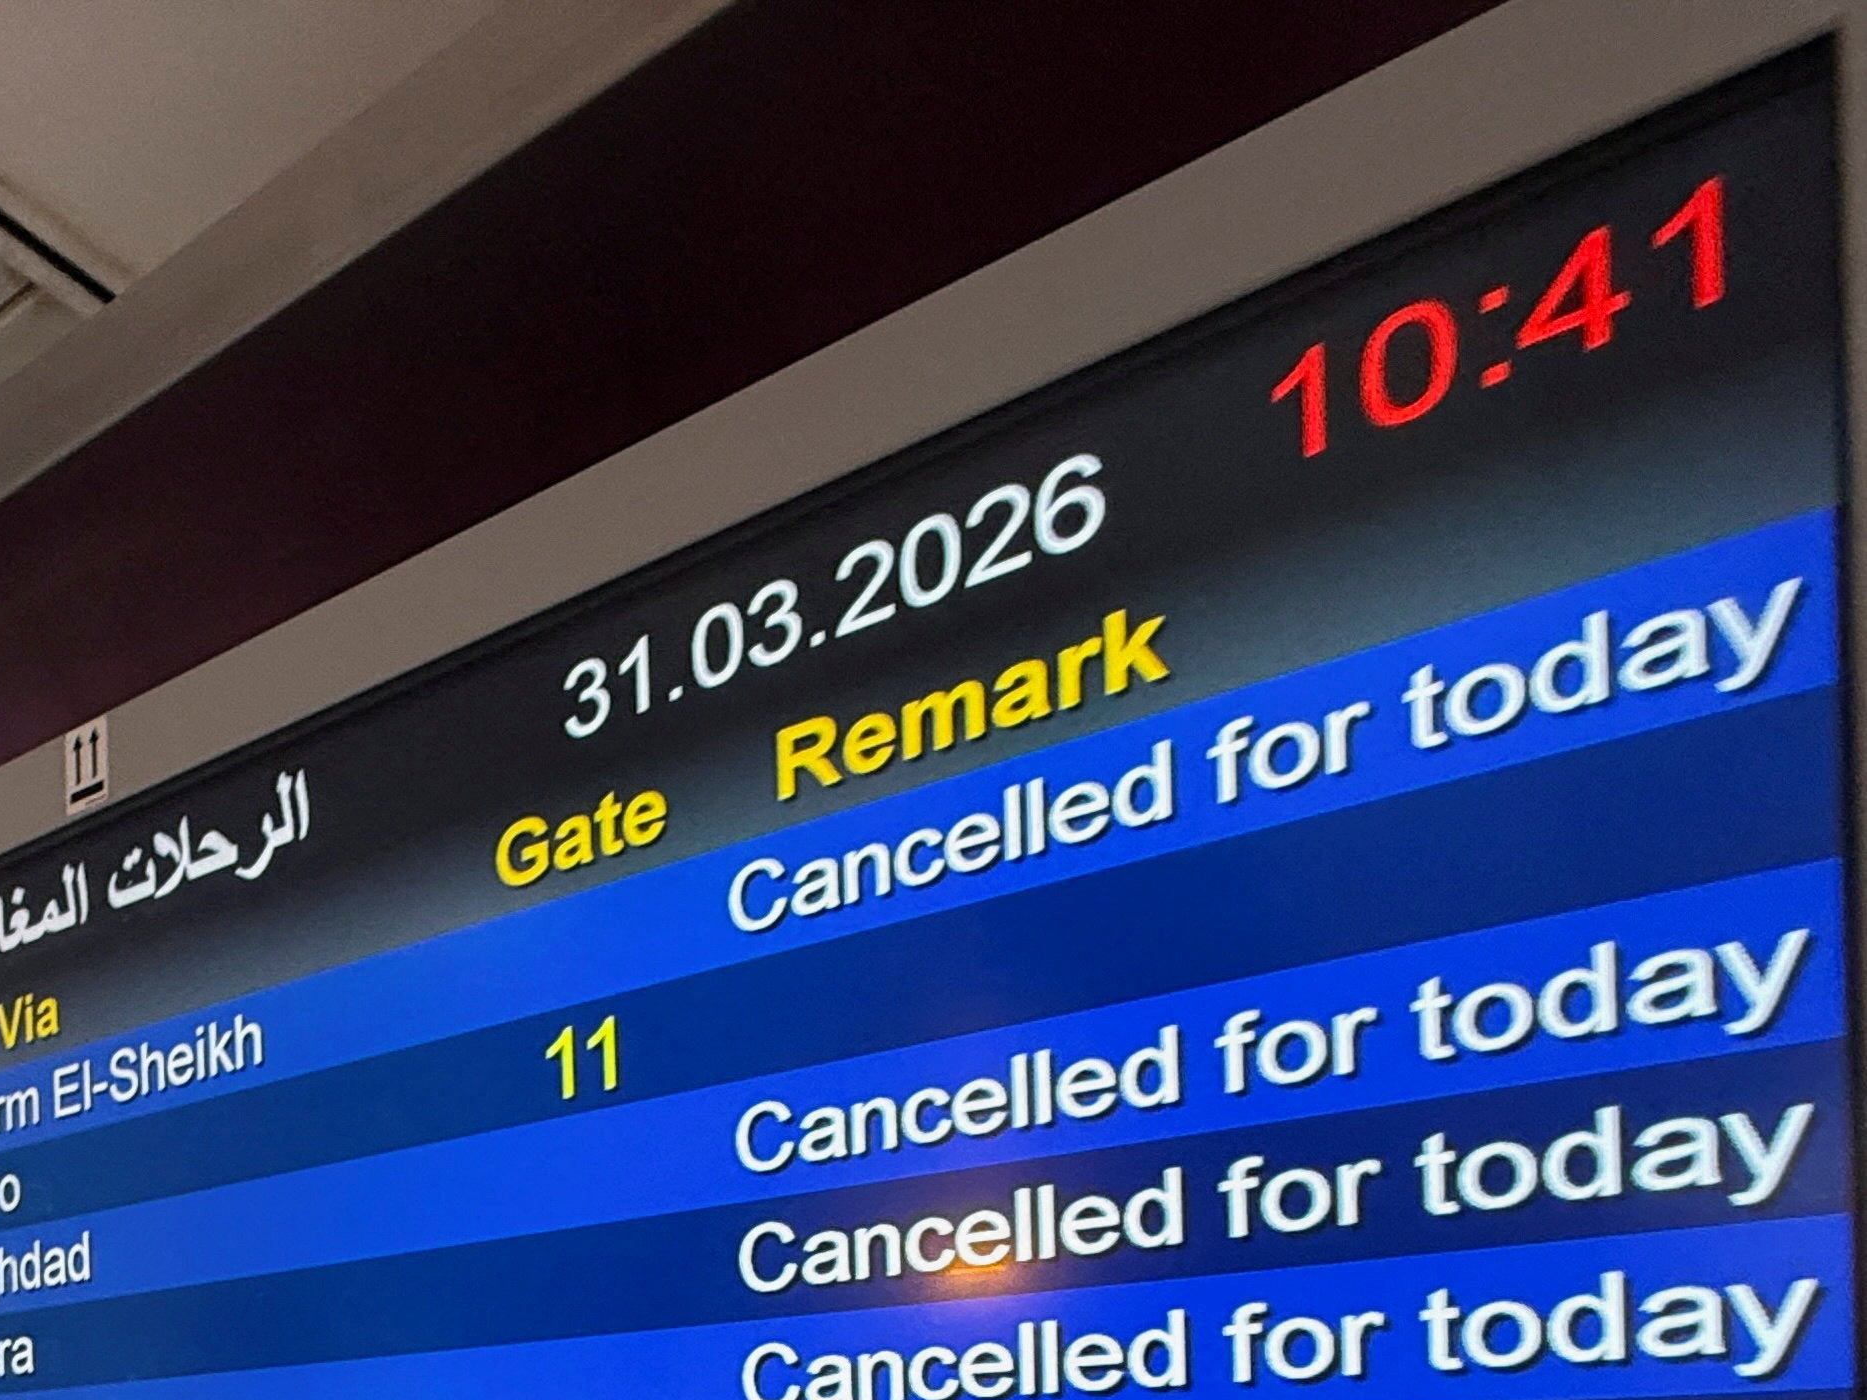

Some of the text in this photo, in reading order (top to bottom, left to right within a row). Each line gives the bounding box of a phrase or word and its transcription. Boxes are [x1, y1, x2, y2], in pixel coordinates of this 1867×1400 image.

[1272, 178, 1723, 457] 10:41
[564, 454, 1105, 737] 31.03.2026
[729, 578, 1802, 931] Cancelled for today
[777, 609, 1168, 800] Remark
[108, 770, 309, 907] الرحلات
[496, 791, 666, 886] Gate
[54, 1015, 262, 1118] El-Sheikh
[546, 1016, 616, 1099] 11
[736, 929, 1808, 1171] Cancelled for today
[739, 1104, 1813, 1295] Cancelled for today
[1223, 1303, 1384, 1382] for
[1420, 1271, 1814, 1376] today
